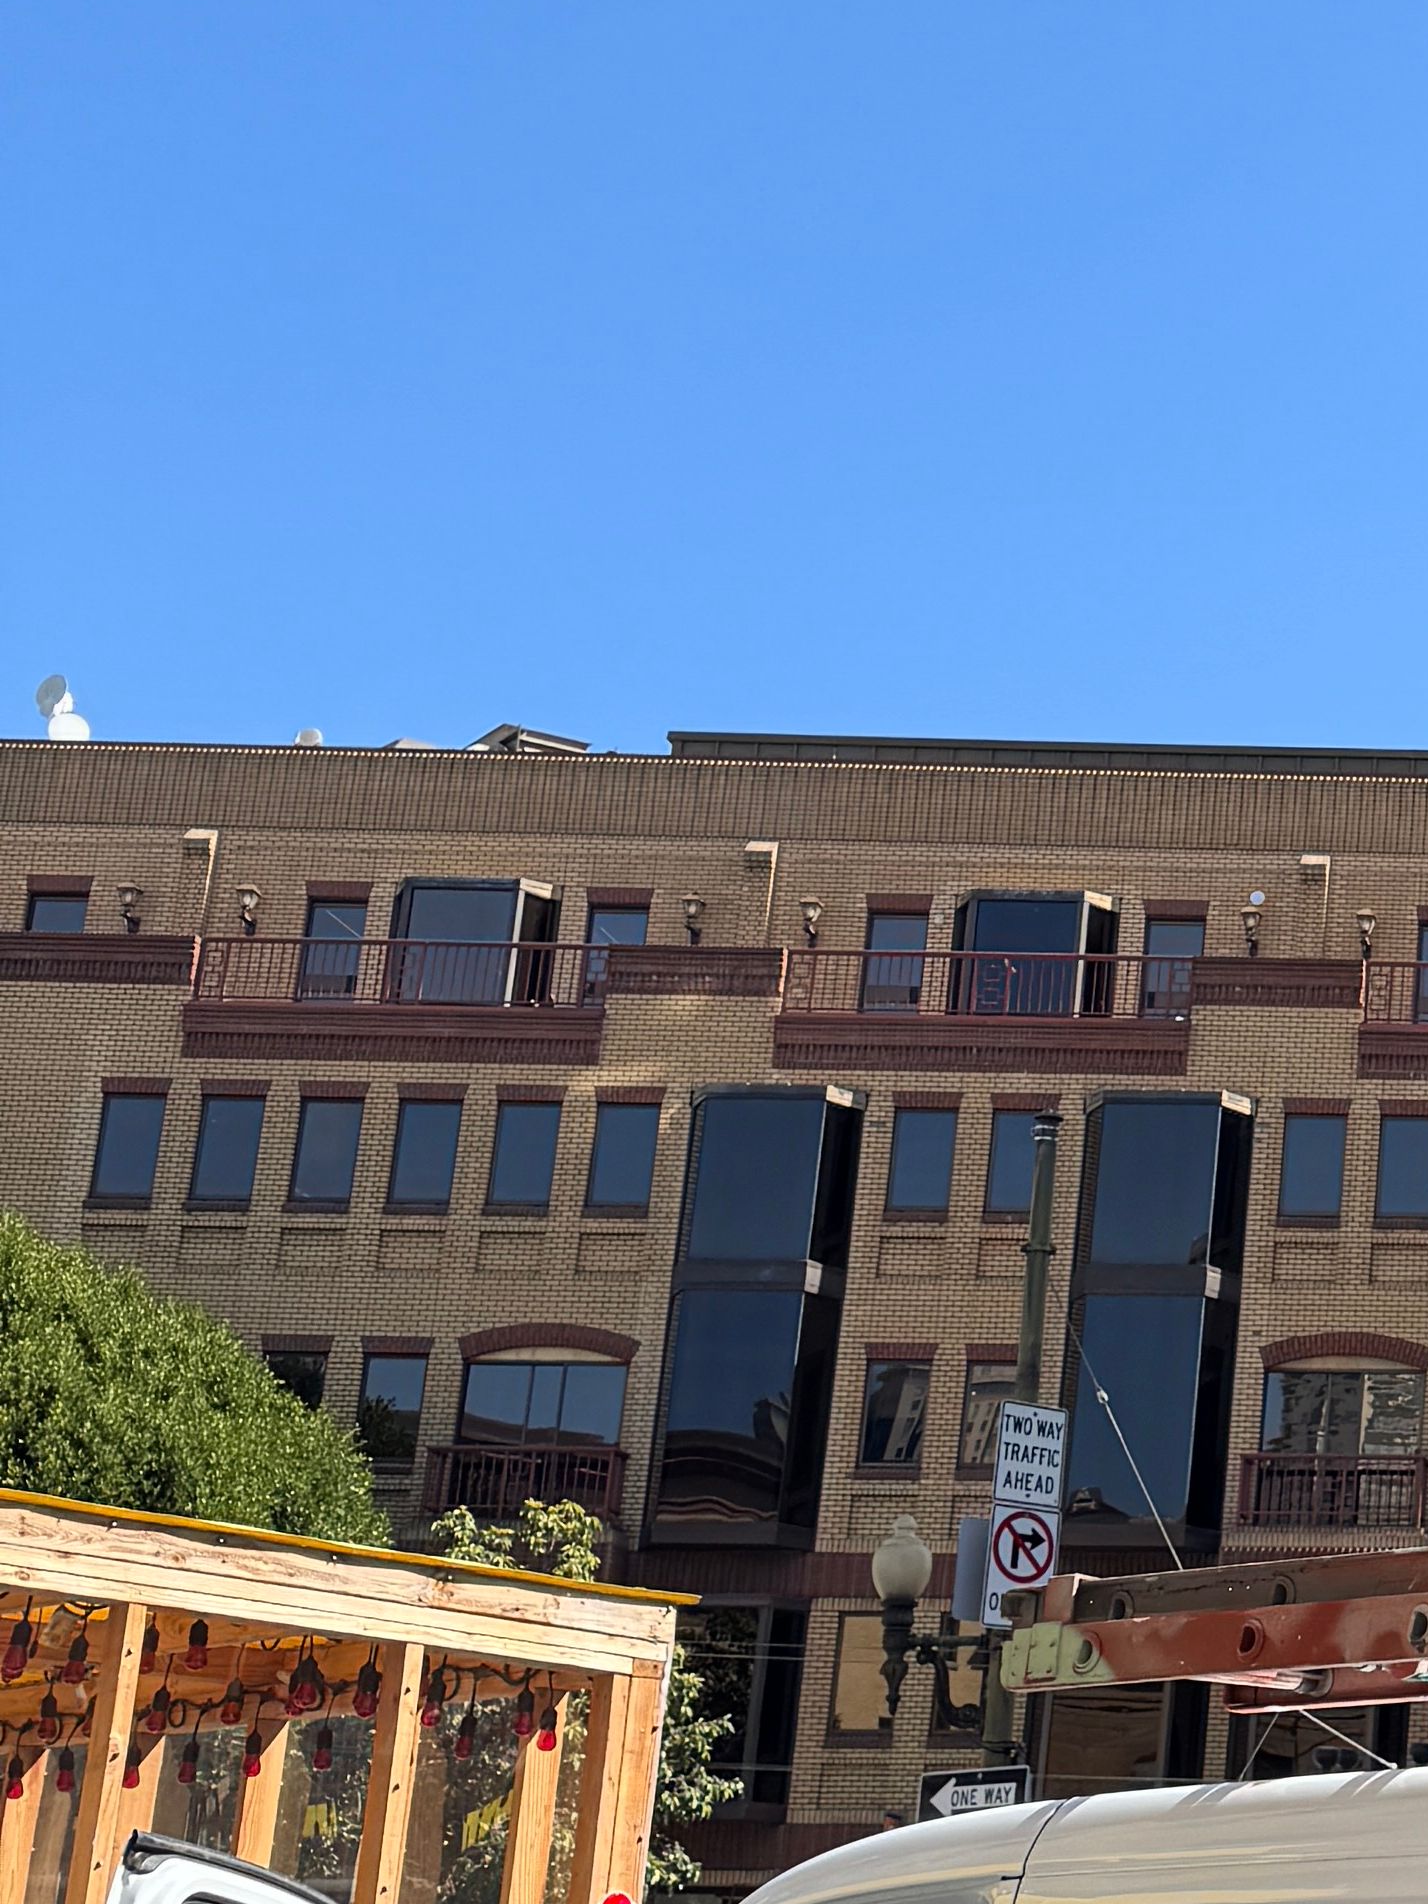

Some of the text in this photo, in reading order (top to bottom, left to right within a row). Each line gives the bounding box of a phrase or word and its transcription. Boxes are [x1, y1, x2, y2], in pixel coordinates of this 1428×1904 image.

[1004, 1414, 1063, 1441] TWO WAY
[1003, 1441, 1060, 1468] TRAFFIC
[1002, 1470, 1055, 1495] AHEAD
[951, 1786, 1012, 1808] ONE WAY
